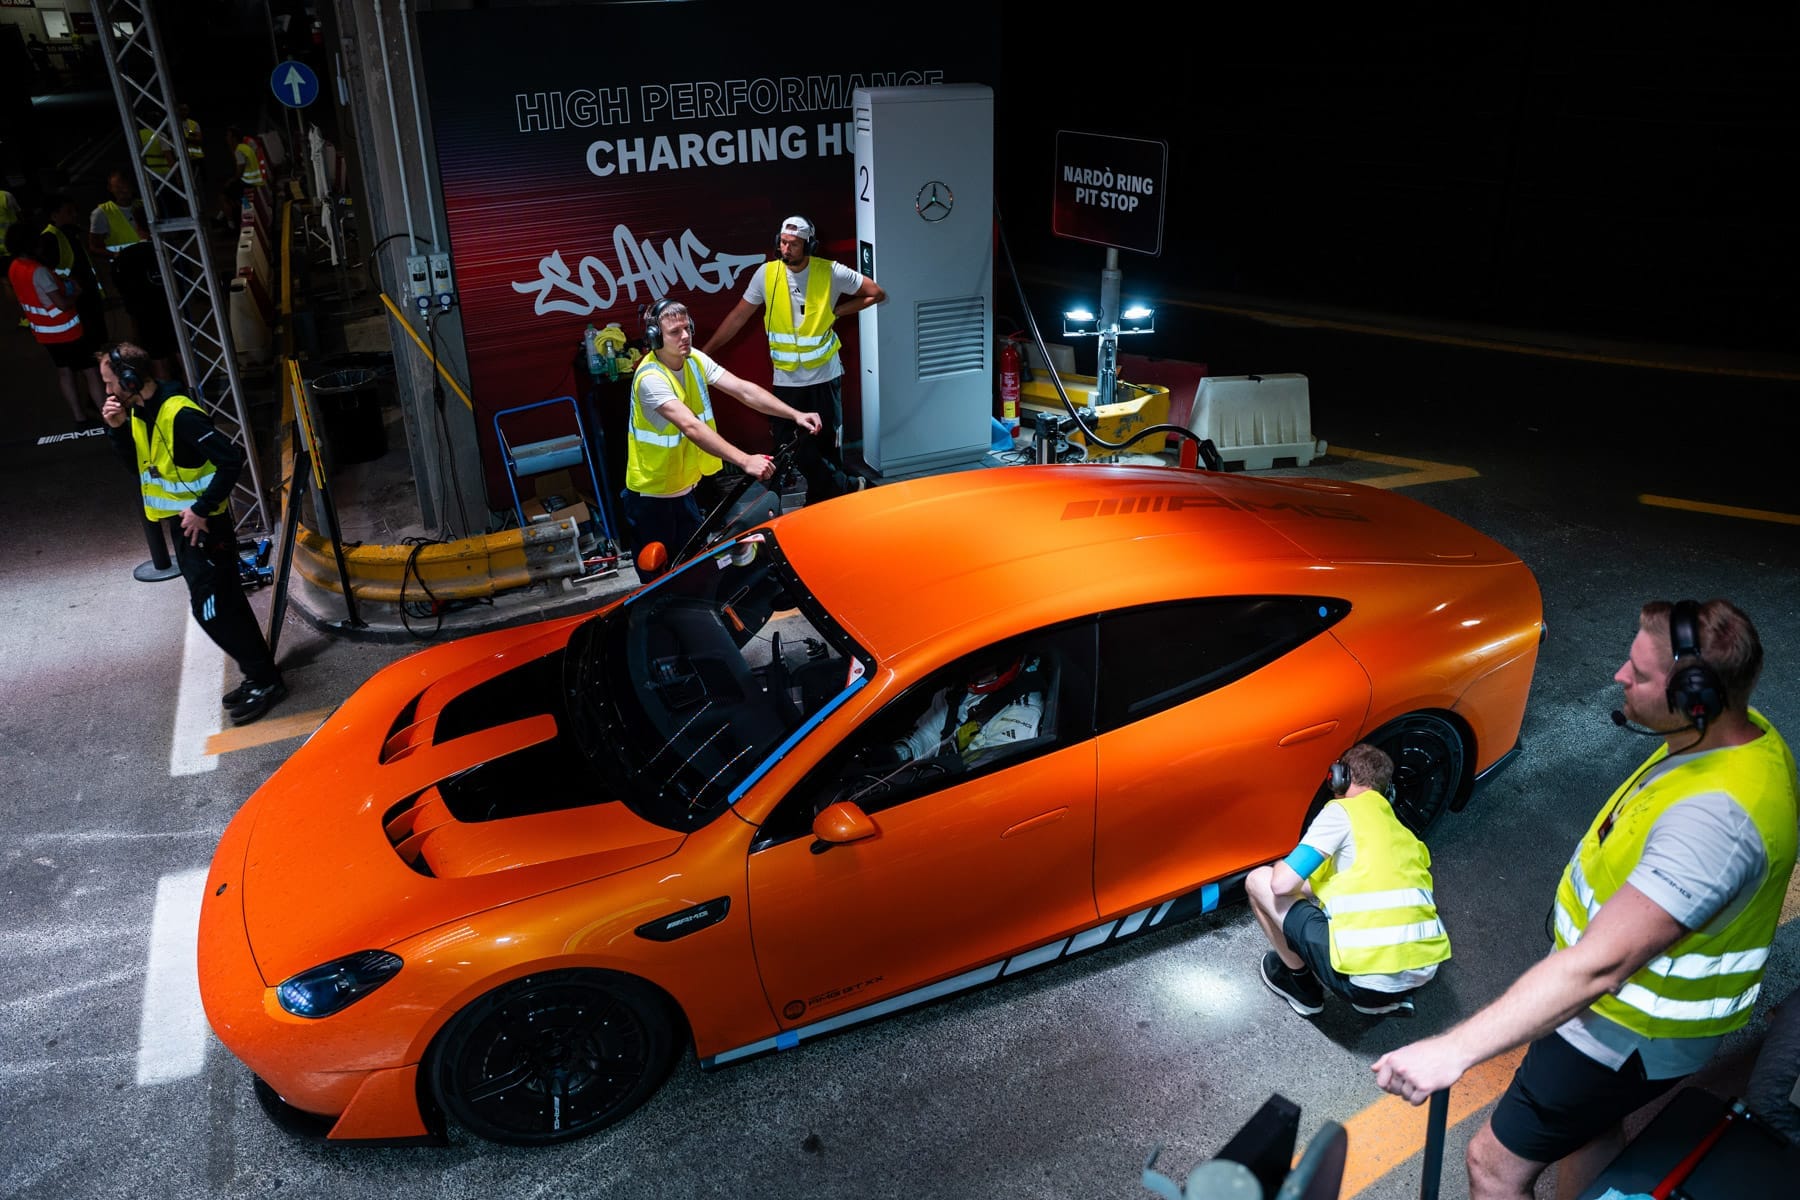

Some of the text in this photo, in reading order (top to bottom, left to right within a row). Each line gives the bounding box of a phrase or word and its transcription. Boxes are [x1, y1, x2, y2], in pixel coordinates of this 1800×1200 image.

[515, 86, 631, 132] HIGH
[585, 124, 807, 177] CHARGING
[859, 165, 870, 202] 2
[1063, 165, 1154, 195] NARDÒ RING
[1075, 187, 1139, 213] PIT STOP
[613, 224, 767, 301] AMG
